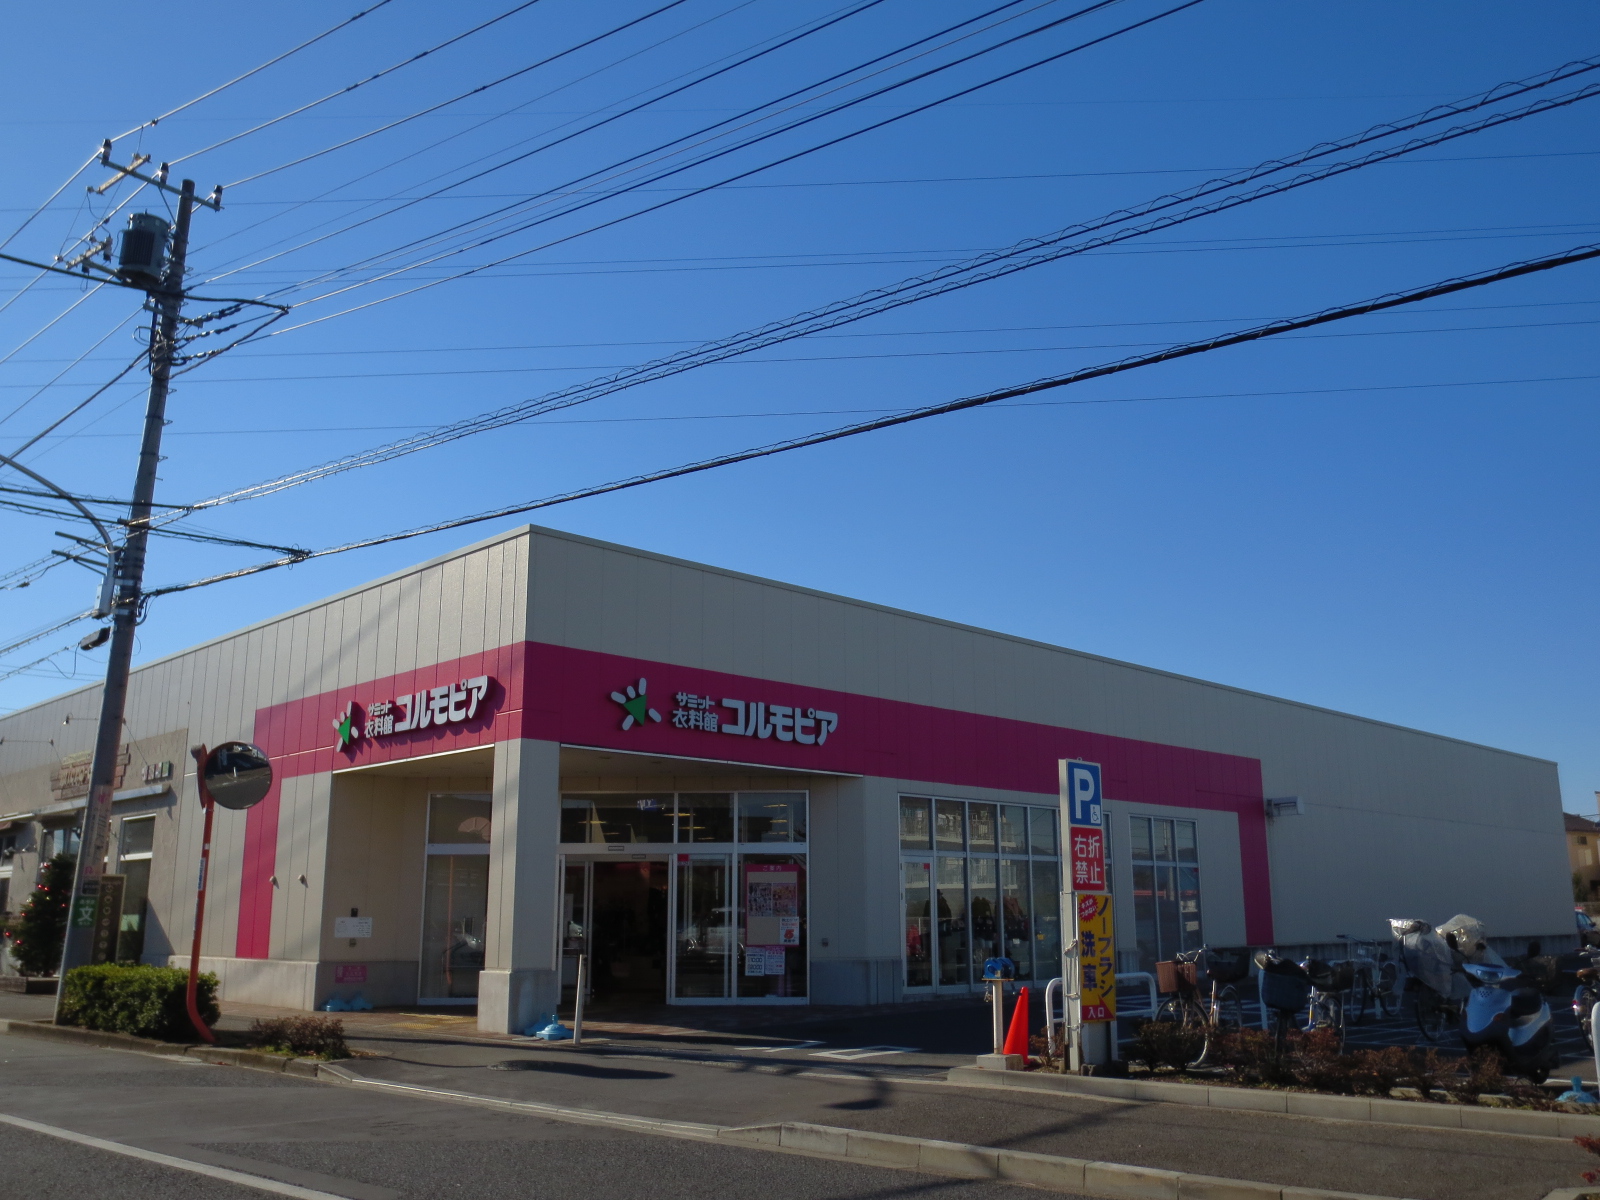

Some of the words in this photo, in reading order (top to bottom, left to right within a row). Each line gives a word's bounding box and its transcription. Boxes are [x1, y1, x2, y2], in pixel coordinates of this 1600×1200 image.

[367, 699, 393, 716] サミット
[395, 675, 489, 733] コルモピア
[675, 691, 716, 710] サミット
[363, 714, 394, 738] 衣料館
[671, 708, 719, 733] 衣料館
[722, 697, 838, 746] コルモピア
[1073, 767, 1095, 819] P
[1074, 834, 1100, 859] 右折
[1075, 860, 1102, 884] 禁止
[77, 906, 94, 921] 文
[1081, 930, 1098, 992] 洗車
[1088, 1006, 1105, 1019] 入口
